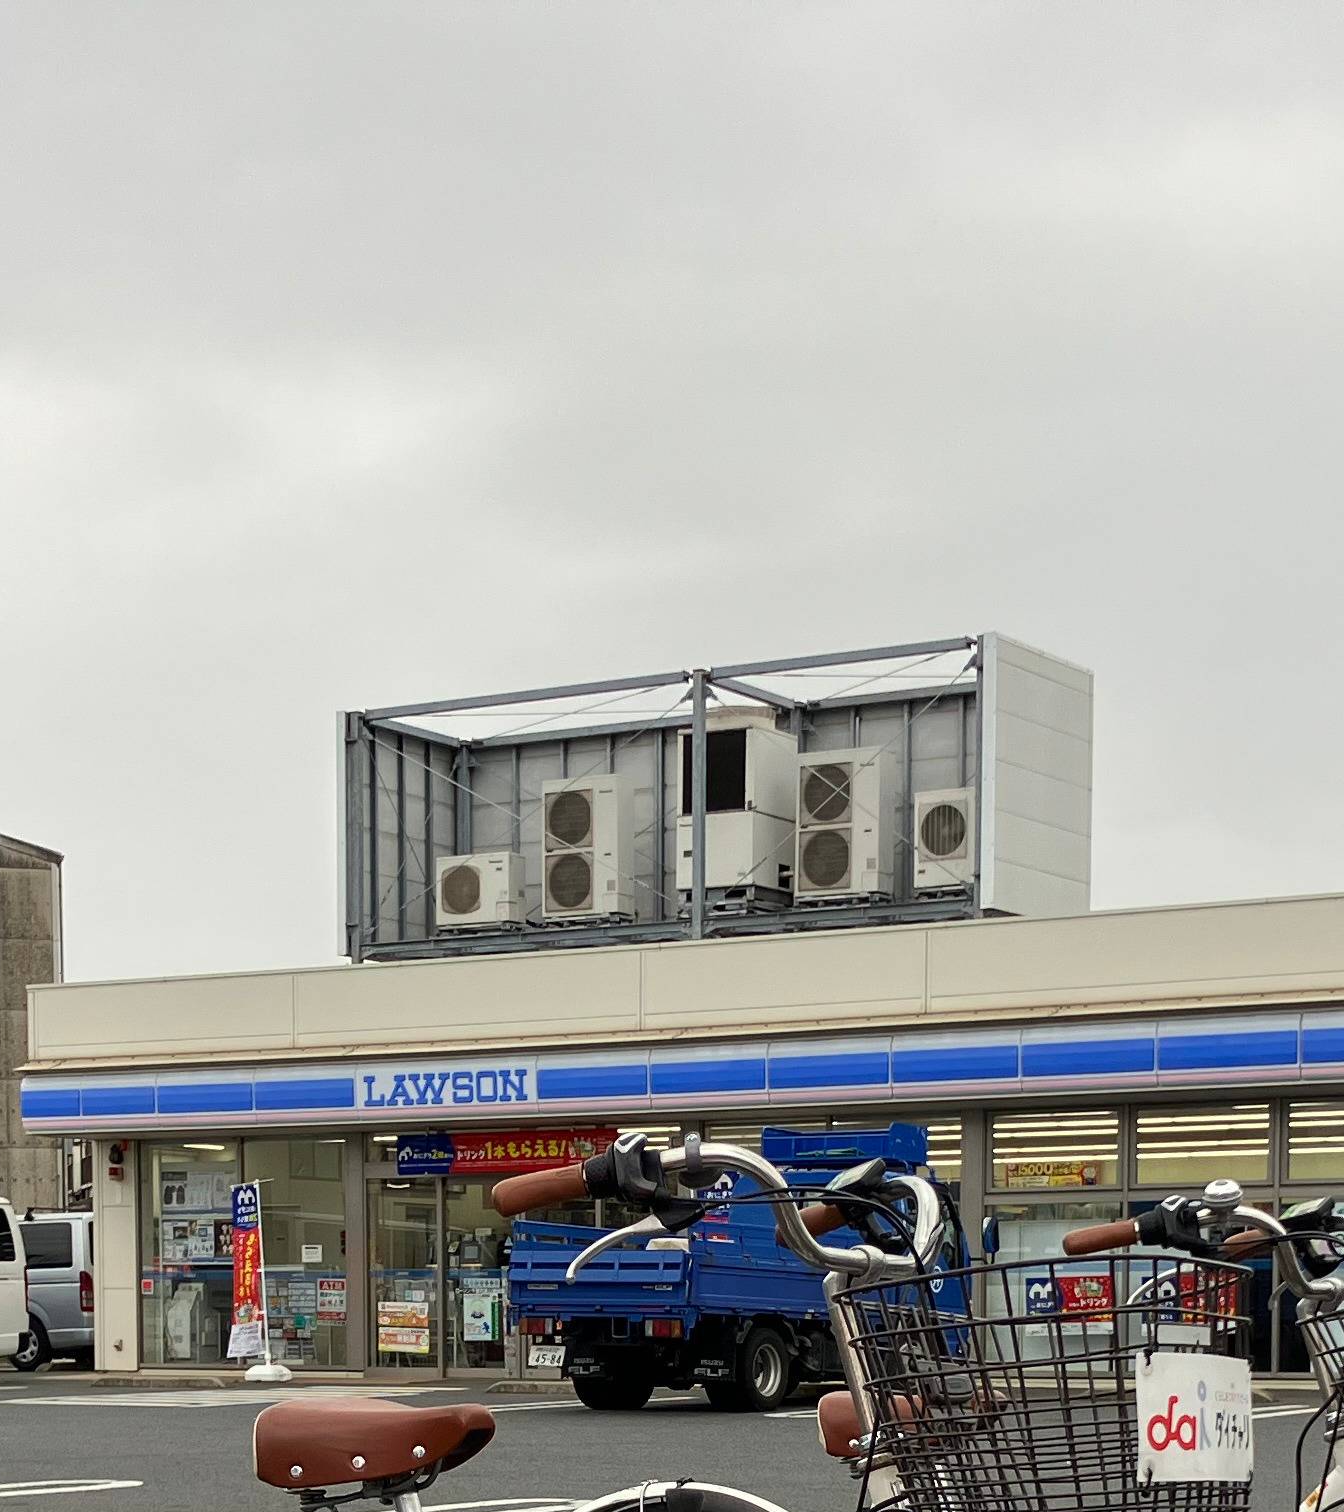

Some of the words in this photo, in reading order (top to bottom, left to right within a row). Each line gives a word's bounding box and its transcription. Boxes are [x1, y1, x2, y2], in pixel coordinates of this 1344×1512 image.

[363, 1069, 528, 1107] LAWSON
[1215, 1410, 1250, 1449] ダイチャリ
